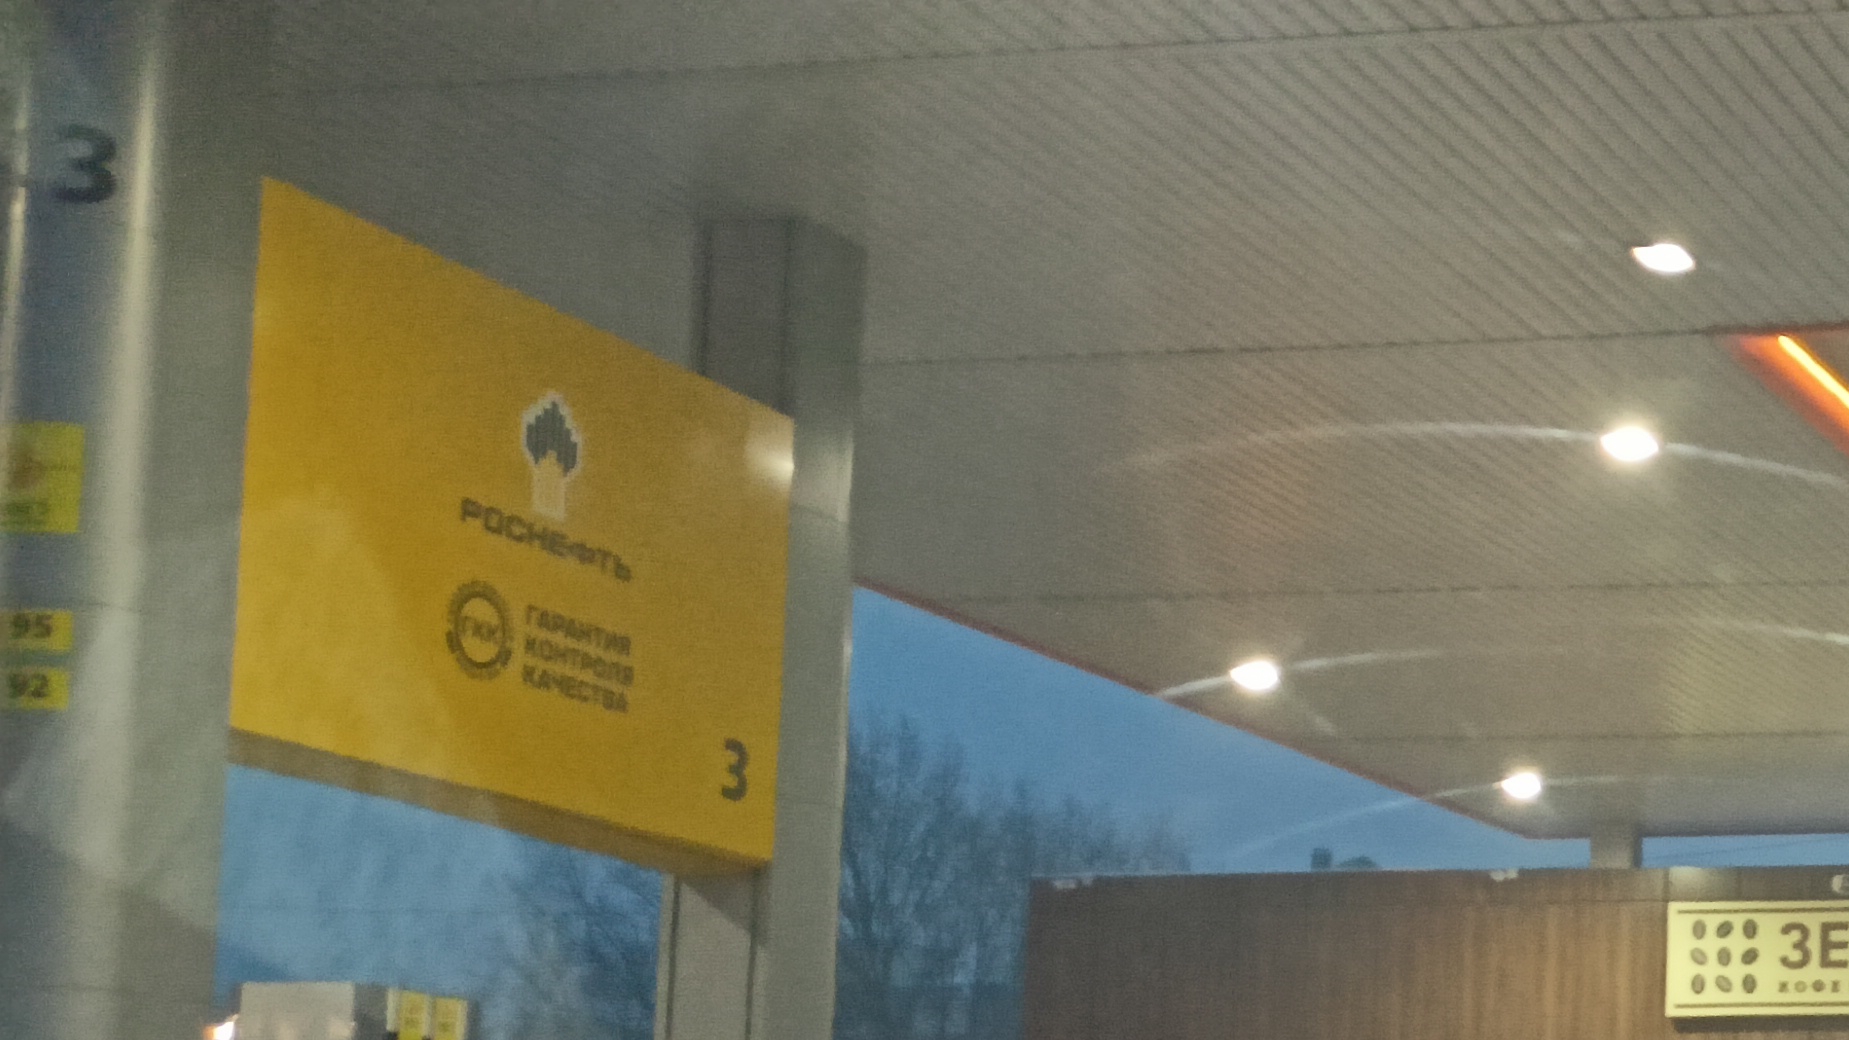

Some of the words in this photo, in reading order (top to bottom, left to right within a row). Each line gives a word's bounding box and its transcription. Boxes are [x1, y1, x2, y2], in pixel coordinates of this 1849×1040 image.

[54, 124, 117, 203] 3
[460, 497, 633, 583] РОСНЕФТЬ
[10, 611, 53, 639] 95
[526, 604, 632, 656] ГАРАНТИЯ
[8, 671, 49, 699] 92
[524, 636, 634, 686] КОНТРОЛЯ
[521, 663, 630, 714] КАЧЕСТВА
[721, 738, 749, 802] 3
[1778, 978, 1840, 994] КОФЕ
